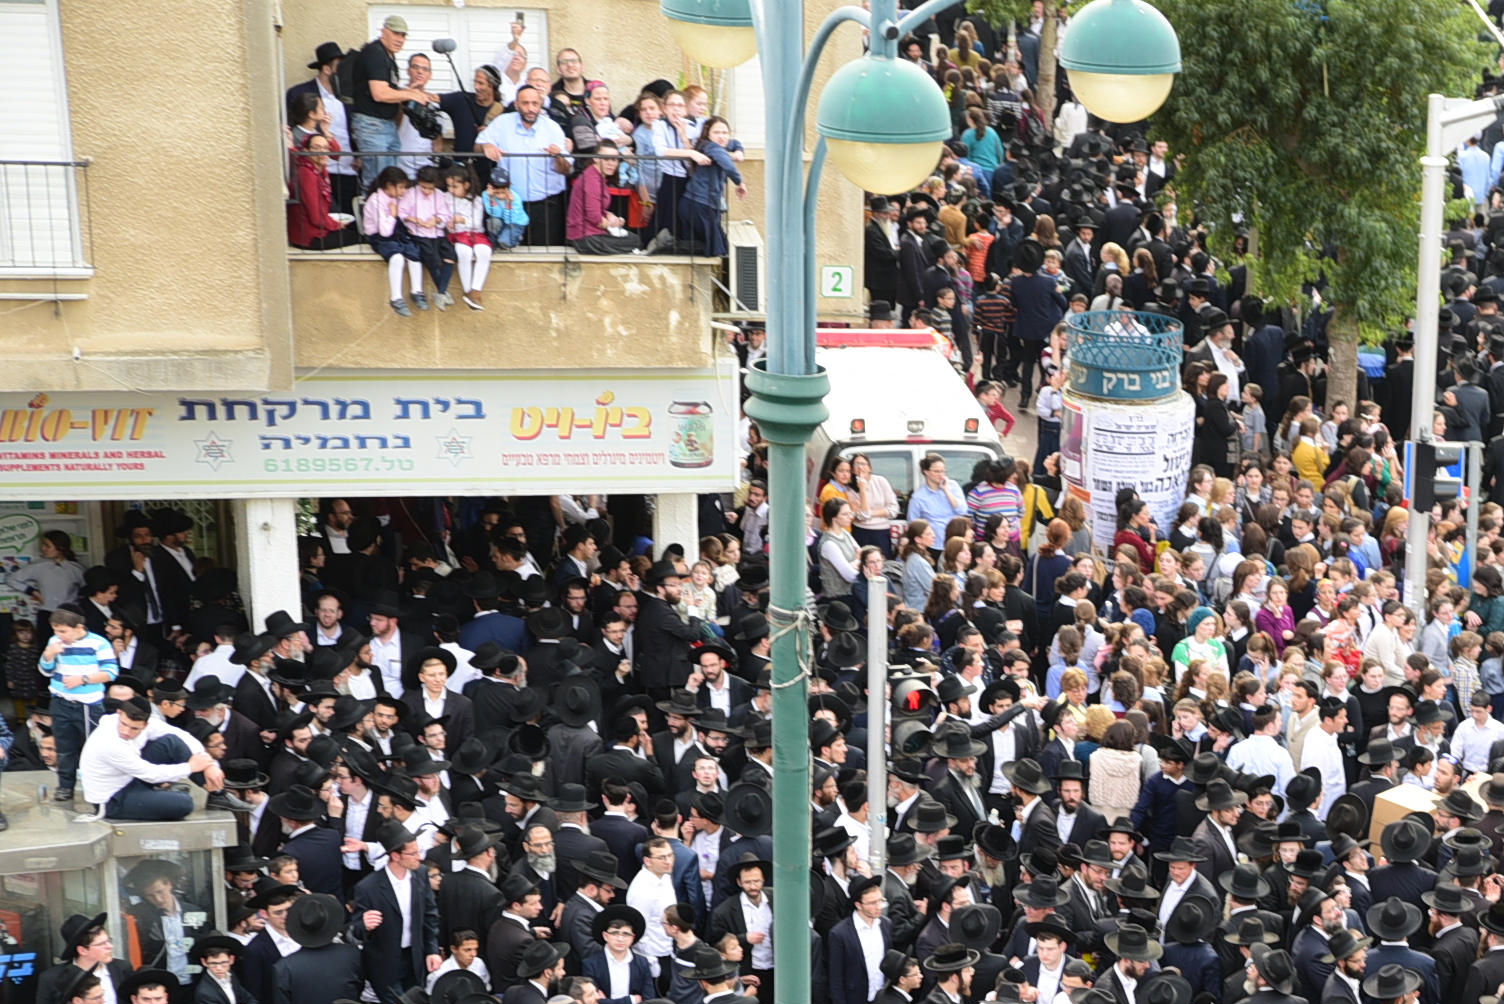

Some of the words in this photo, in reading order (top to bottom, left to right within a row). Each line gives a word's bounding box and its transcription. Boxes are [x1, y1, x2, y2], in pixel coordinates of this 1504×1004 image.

[831, 271, 843, 292] 2
[1102, 371, 1141, 395] ברק
[1150, 370, 1171, 389] בני
[177, 397, 371, 427] מרקחת
[392, 396, 487, 420] בית
[509, 404, 653, 440] ביו-ויט
[258, 433, 412, 450] נחמיה
[50, 451, 99, 460] MINERALS
[103, 450, 123, 459] AND
[126, 450, 166, 459] HERBAL
[501, 452, 534, 467] טבעיים
[536, 452, 561, 466] מרפא
[592, 450, 626, 465] מינרלים
[63, 463, 113, 472] NATURALLY
[116, 462, 145, 470] YOURS
